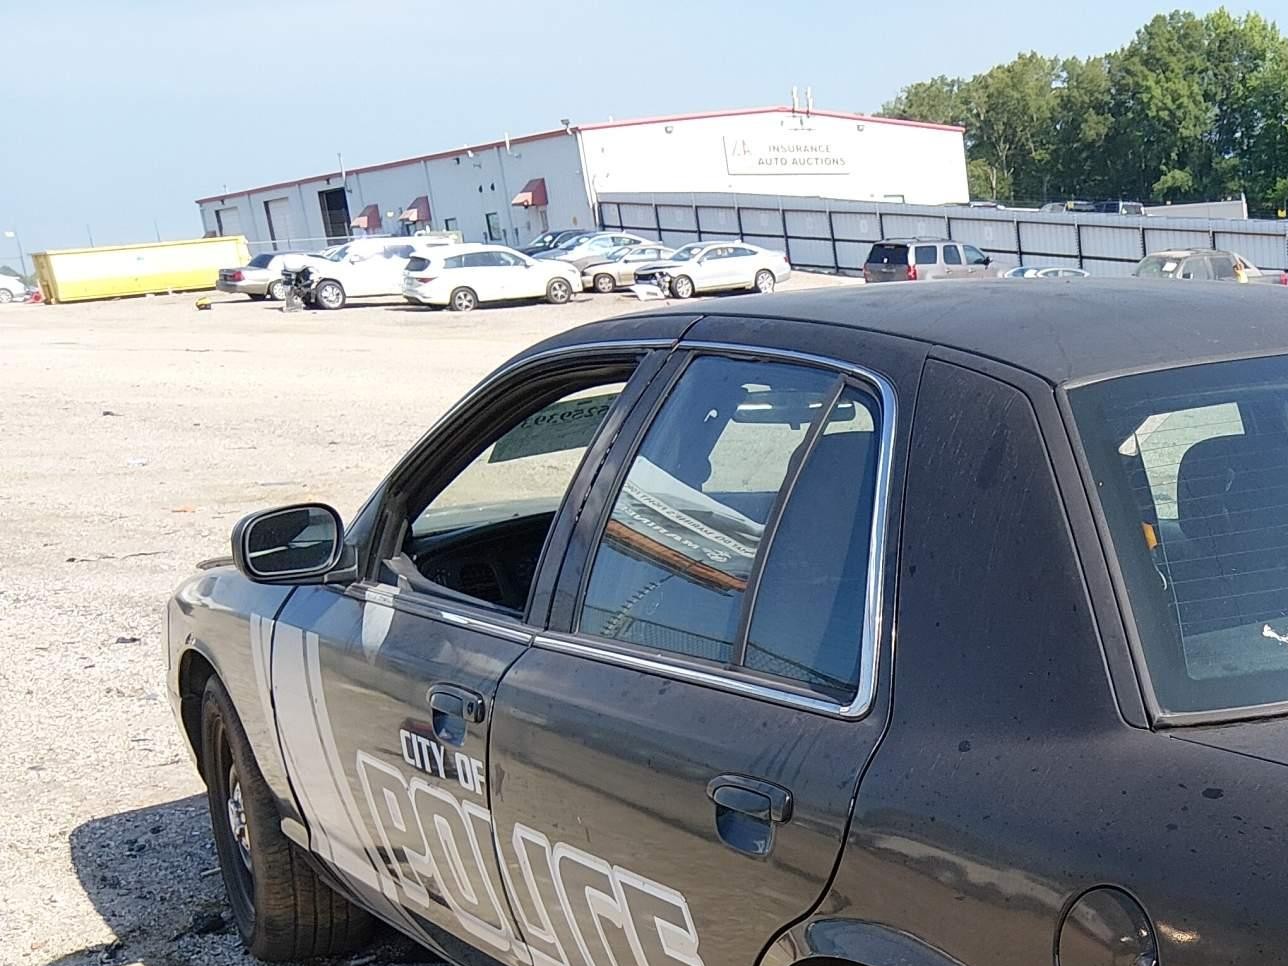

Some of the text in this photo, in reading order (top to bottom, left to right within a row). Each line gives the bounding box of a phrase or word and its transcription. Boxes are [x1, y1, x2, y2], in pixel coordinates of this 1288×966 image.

[767, 144, 832, 154] INSURANCE
[757, 157, 847, 166] AUTO AUCTIONS
[400, 729, 486, 795] CITY OF
